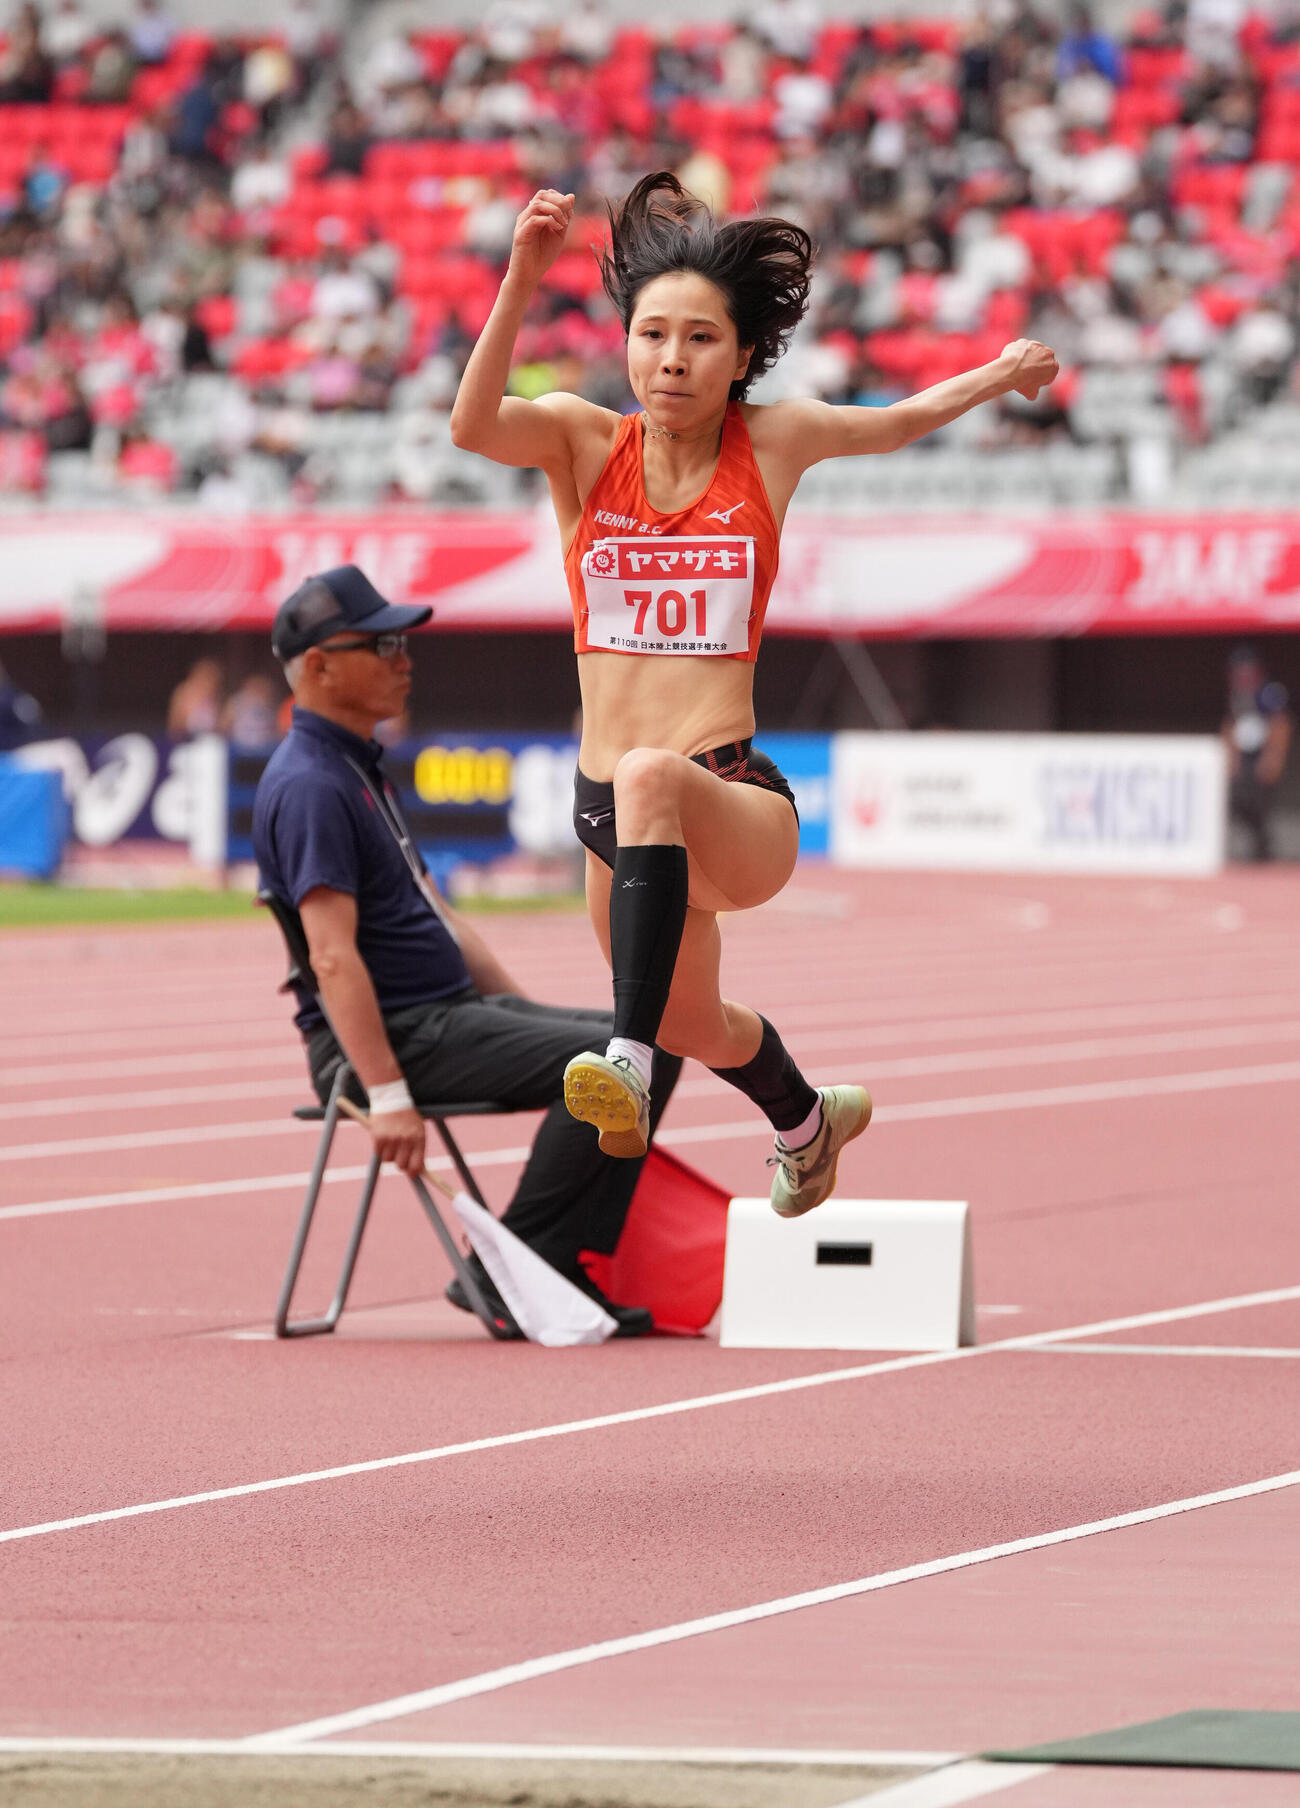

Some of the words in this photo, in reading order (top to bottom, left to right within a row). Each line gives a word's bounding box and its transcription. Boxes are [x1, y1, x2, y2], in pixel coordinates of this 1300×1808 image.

[594, 509, 638, 530] KENNY
[626, 549, 739, 572] ヤマザキ
[624, 590, 707, 637] 701
